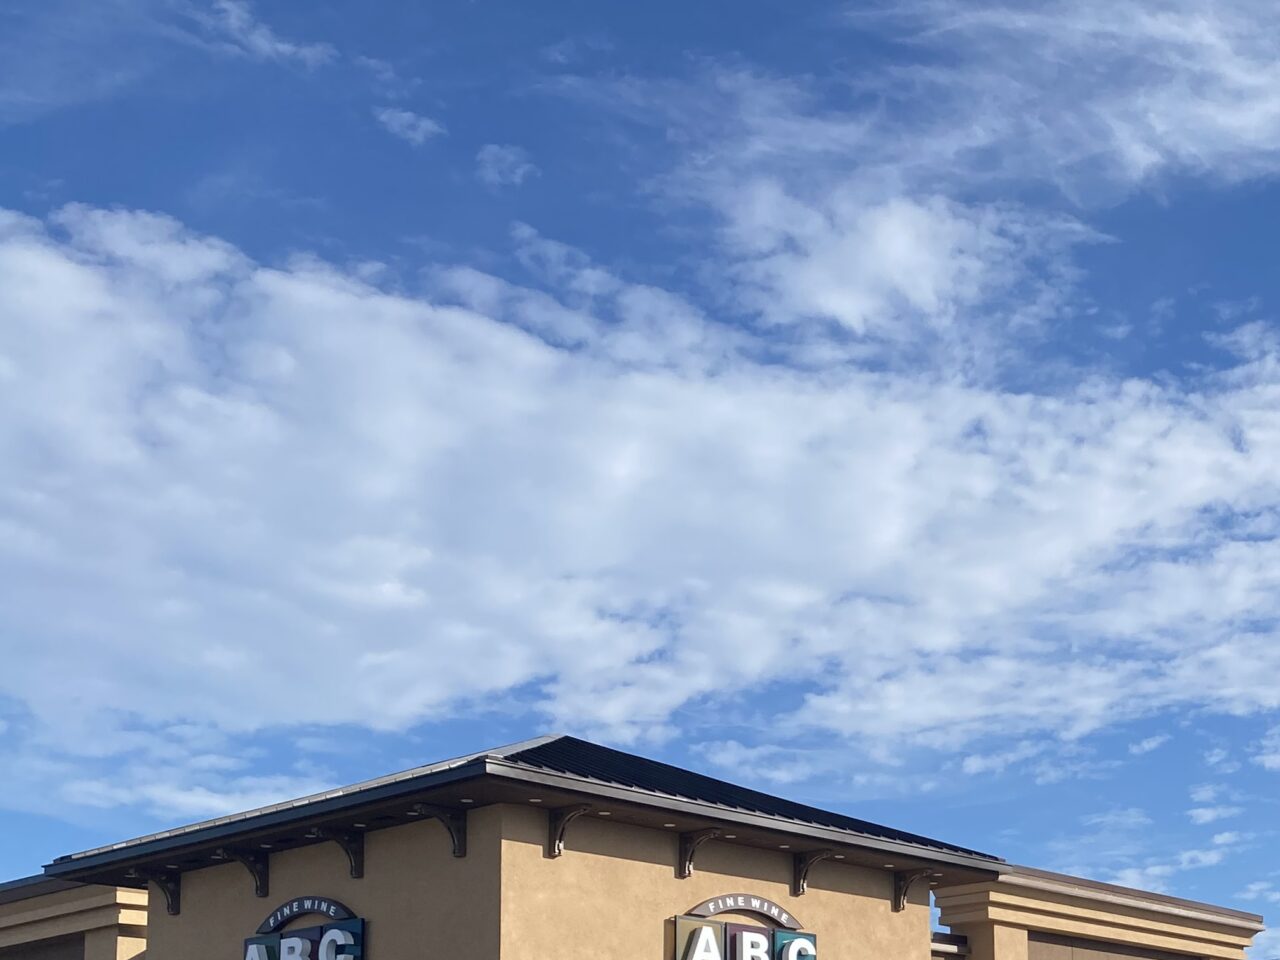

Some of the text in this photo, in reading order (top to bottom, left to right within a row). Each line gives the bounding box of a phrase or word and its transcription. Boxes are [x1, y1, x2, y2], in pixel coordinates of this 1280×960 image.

[269, 899, 337, 927] FINE WINE
[708, 896, 789, 924] FINE WINE
